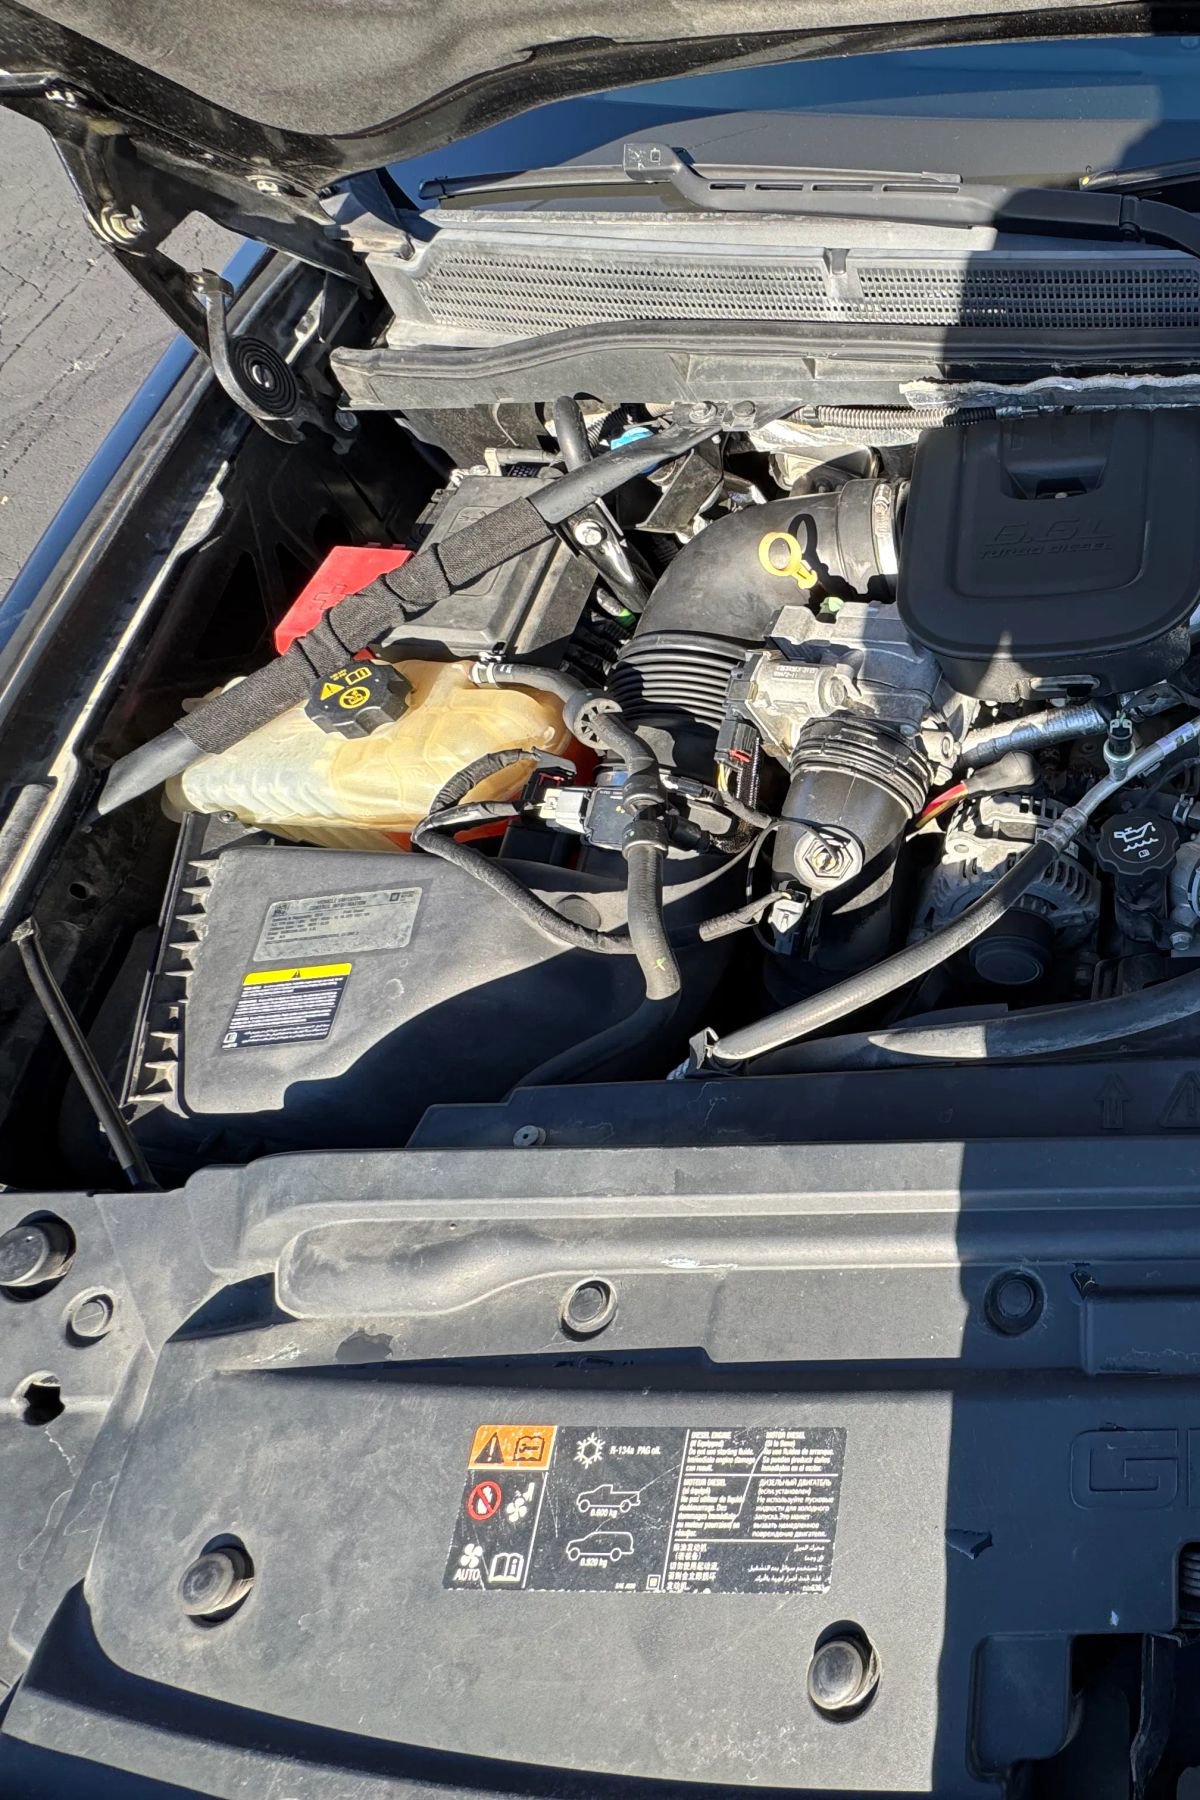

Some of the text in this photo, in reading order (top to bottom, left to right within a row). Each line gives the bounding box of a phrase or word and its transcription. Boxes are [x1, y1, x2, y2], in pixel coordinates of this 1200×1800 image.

[610, 1446, 634, 1455] R-134a
[636, 1446, 651, 1455] PAG
[453, 1568, 481, 1581] AUTO
